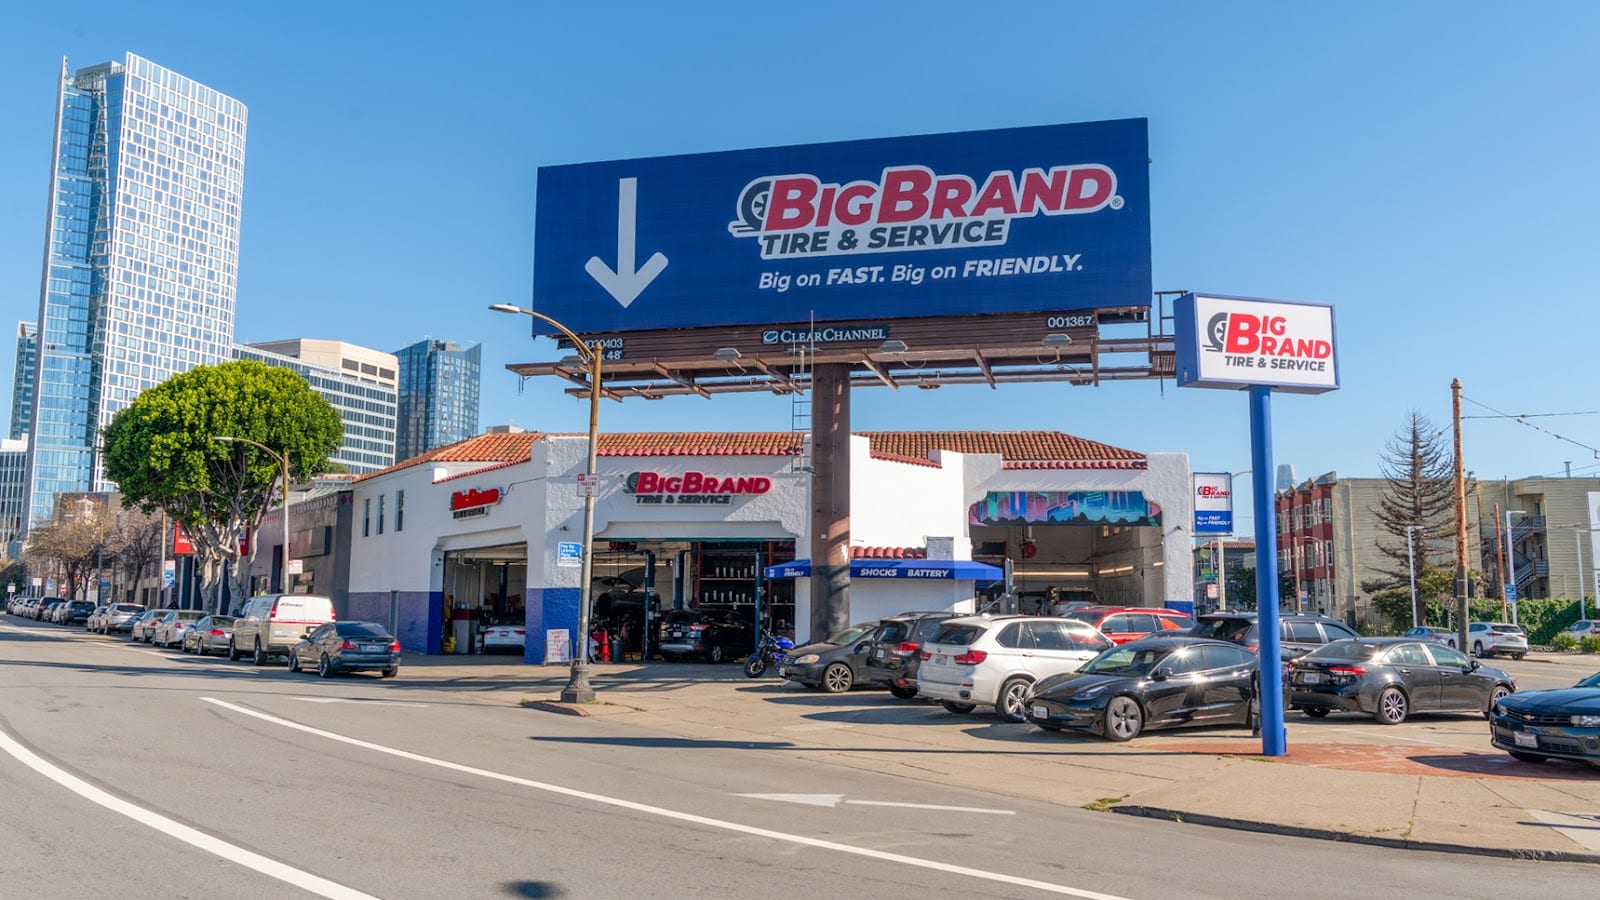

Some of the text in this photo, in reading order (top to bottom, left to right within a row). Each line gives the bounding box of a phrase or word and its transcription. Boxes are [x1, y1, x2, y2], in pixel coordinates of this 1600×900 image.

[762, 219, 1005, 255] TIRE & SERVICE
[759, 254, 1083, 292] Big on FAST. Big on FRIENDLY.
[1047, 316, 1092, 327] 001367
[1225, 356, 1325, 372] TIRE & SERVICE
[635, 495, 731, 504] TIRE & SERVICE
[860, 568, 949, 578] SHOCKS BATTERY
